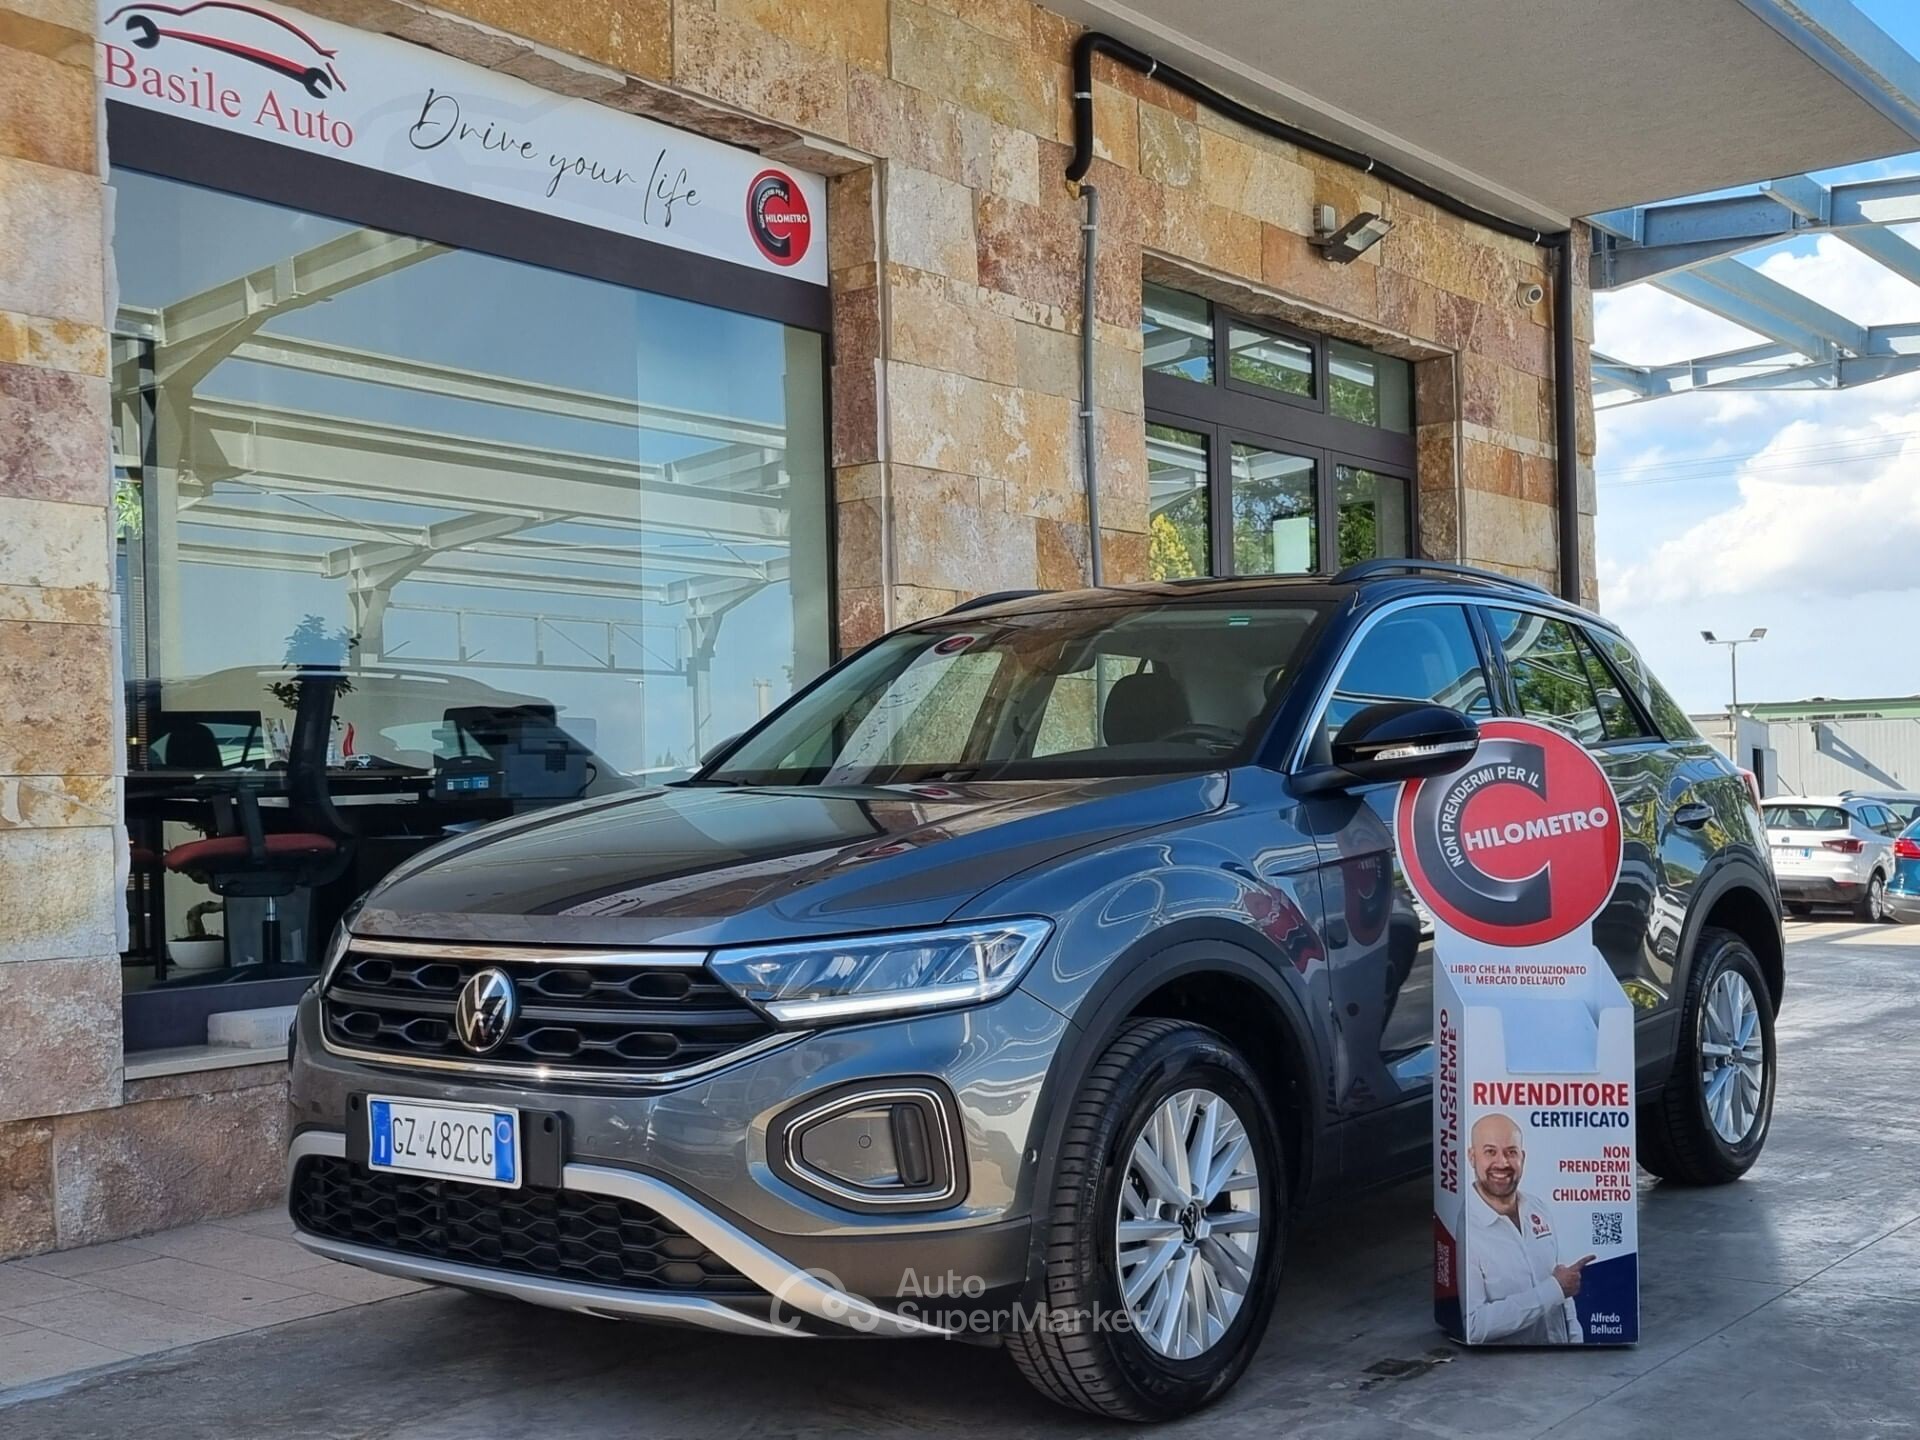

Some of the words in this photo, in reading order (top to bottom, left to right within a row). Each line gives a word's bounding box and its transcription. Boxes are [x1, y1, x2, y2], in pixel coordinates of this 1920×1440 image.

[104, 44, 241, 119] Basile
[253, 90, 355, 148] Auto
[409, 88, 538, 159] Drive
[549, 150, 636, 198] your
[643, 149, 702, 228] life
[1497, 766, 1526, 781] PER
[1528, 771, 1540, 788] IL
[1442, 767, 1495, 833] PRENDERMI
[1442, 836, 1465, 868] NON
[1450, 964, 1477, 974] LIBRO
[1479, 964, 1496, 974] CHE
[1498, 964, 1511, 974] HA
[1515, 965, 1587, 975] RIVOLUZIONATO
[1464, 975, 1472, 984] IL
[1476, 975, 1518, 985] MERCATO
[1520, 975, 1566, 986] DELL'AUTO
[1440, 1008, 1449, 1120] CONTRO
[1448, 1028, 1457, 1142] INSIEME
[1473, 1082, 1629, 1107] RIVENDITORE
[1530, 1111, 1630, 1128] CERTIFICATO
[392, 1117, 417, 1156] GZ
[426, 1120, 493, 1165] 482CG
[1440, 1128, 1449, 1190] NON
[1603, 1146, 1630, 1158] NON
[1449, 1150, 1458, 1194] MA
[1559, 1160, 1630, 1173] PRENDERMI
[1595, 1175, 1618, 1187] PER
[1621, 1175, 1631, 1187] IL
[1552, 1188, 1631, 1202] CHILOMETRO
[1591, 1312, 1621, 1323] Alfredo
[1591, 1324, 1622, 1334] Bellucci
